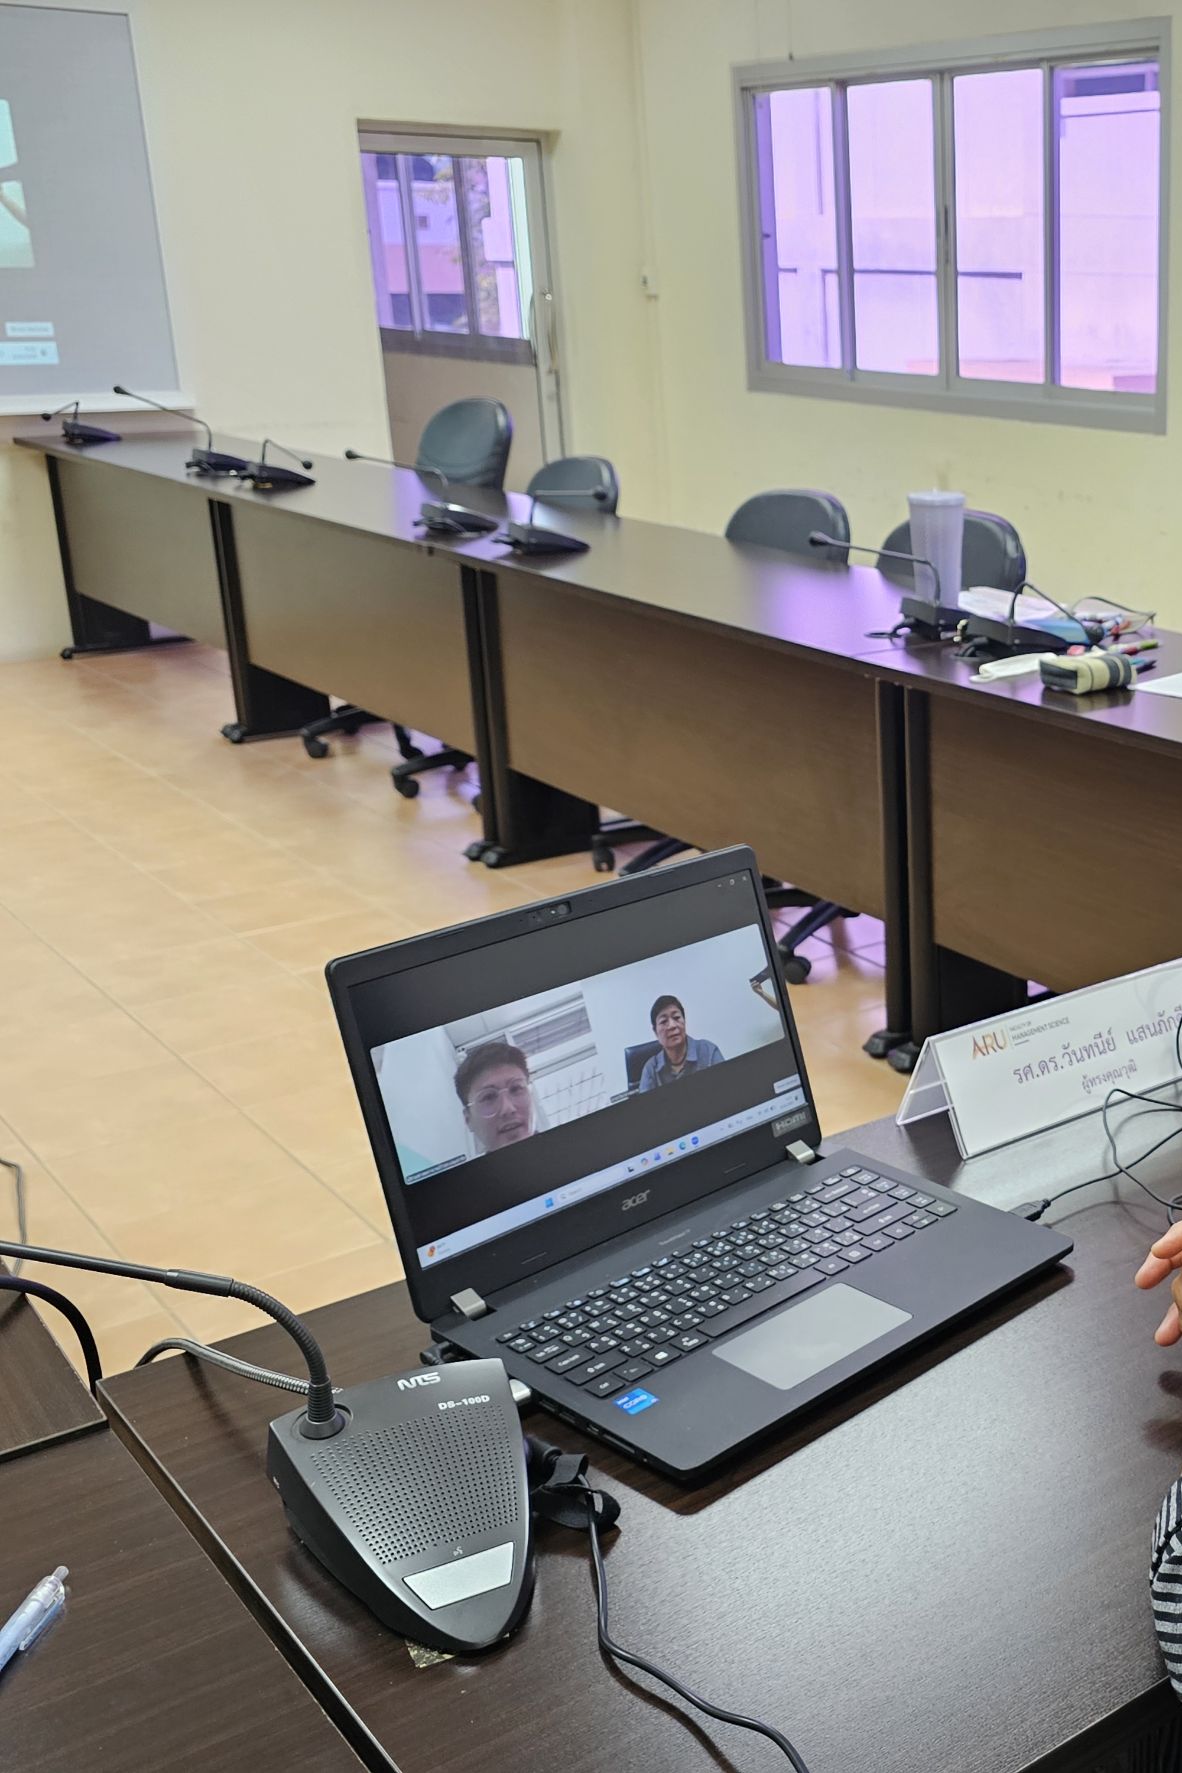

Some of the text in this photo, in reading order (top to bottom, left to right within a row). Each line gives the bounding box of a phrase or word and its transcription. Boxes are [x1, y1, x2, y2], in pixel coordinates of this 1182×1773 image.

[972, 1029, 1008, 1060] ARU
[621, 1189, 650, 1211] acer
[397, 1372, 441, 1391] NTS
[438, 1395, 491, 1410] DS-100D
